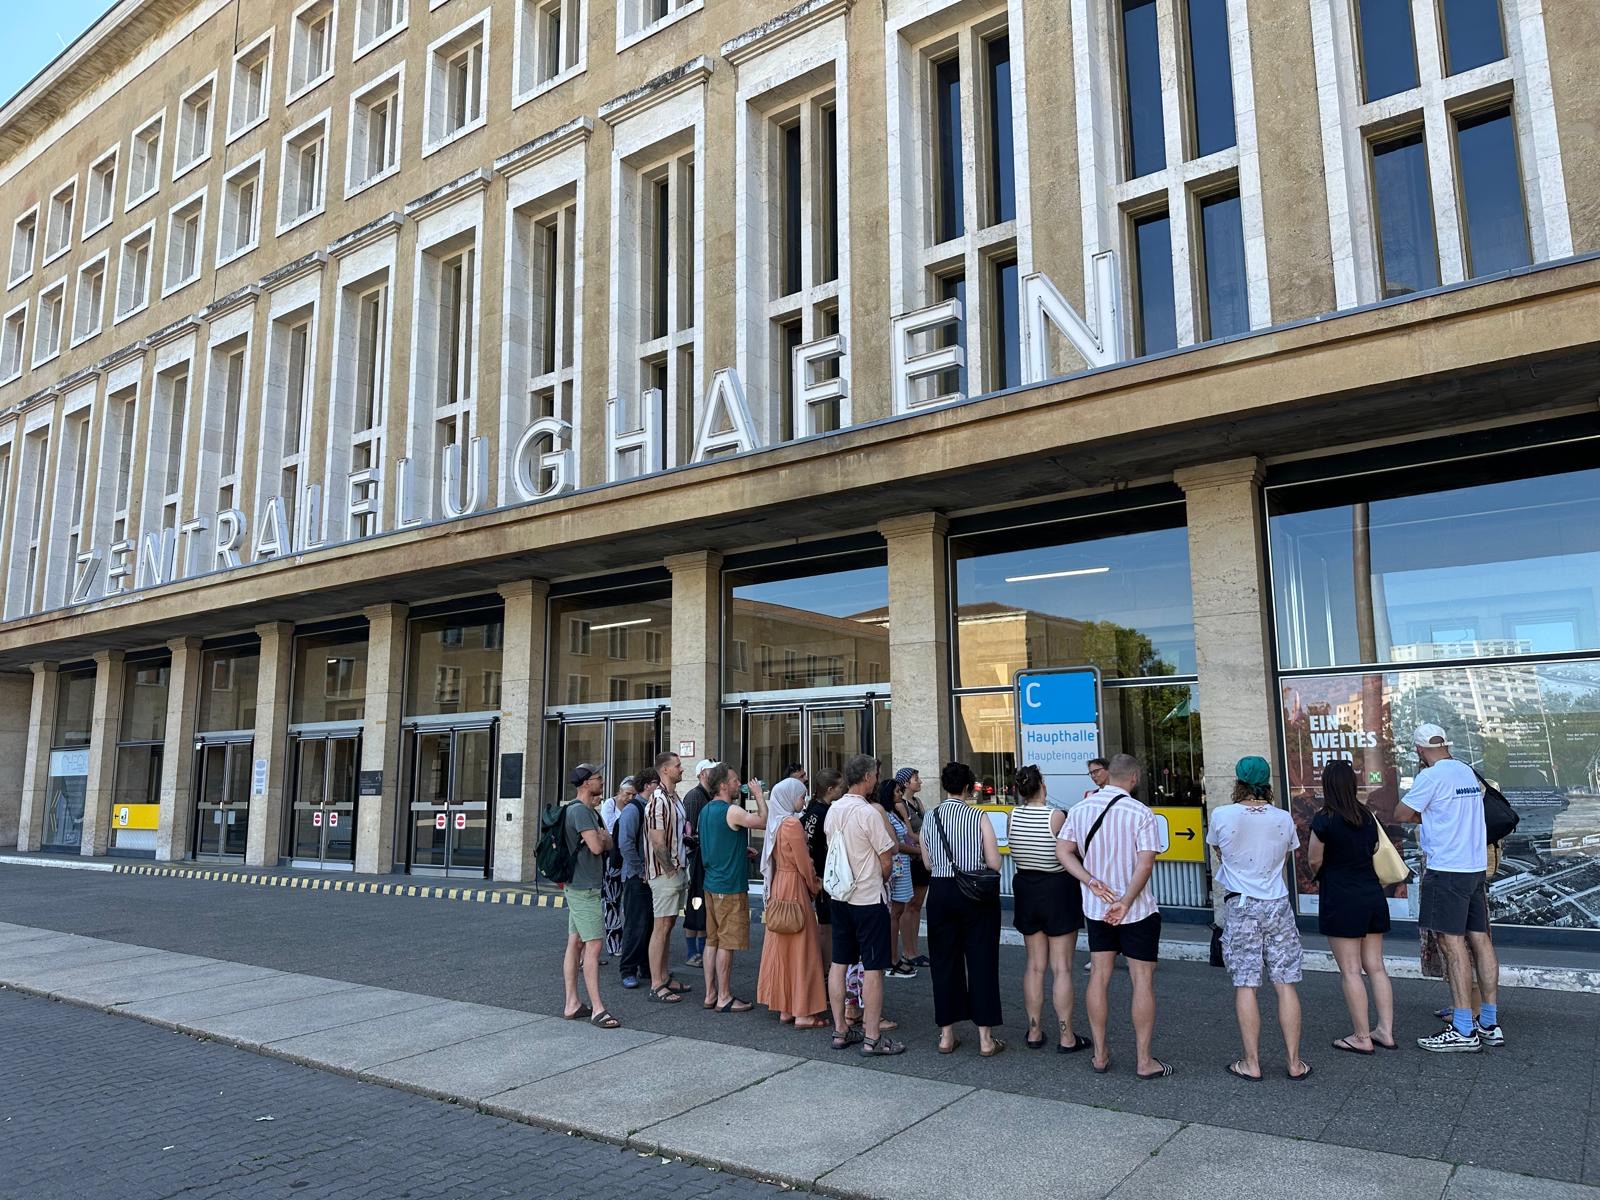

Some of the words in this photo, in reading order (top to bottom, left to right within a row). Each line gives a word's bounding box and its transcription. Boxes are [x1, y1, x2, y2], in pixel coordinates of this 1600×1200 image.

[71, 250, 1132, 605] ZENTRALFLUGHAFEN
[1026, 682, 1042, 708] C
[1309, 715, 1340, 731] EIN
[1027, 730, 1095, 745] Haupthalle
[1310, 731, 1377, 749] WEITES
[1027, 751, 1095, 763] Haupteingang
